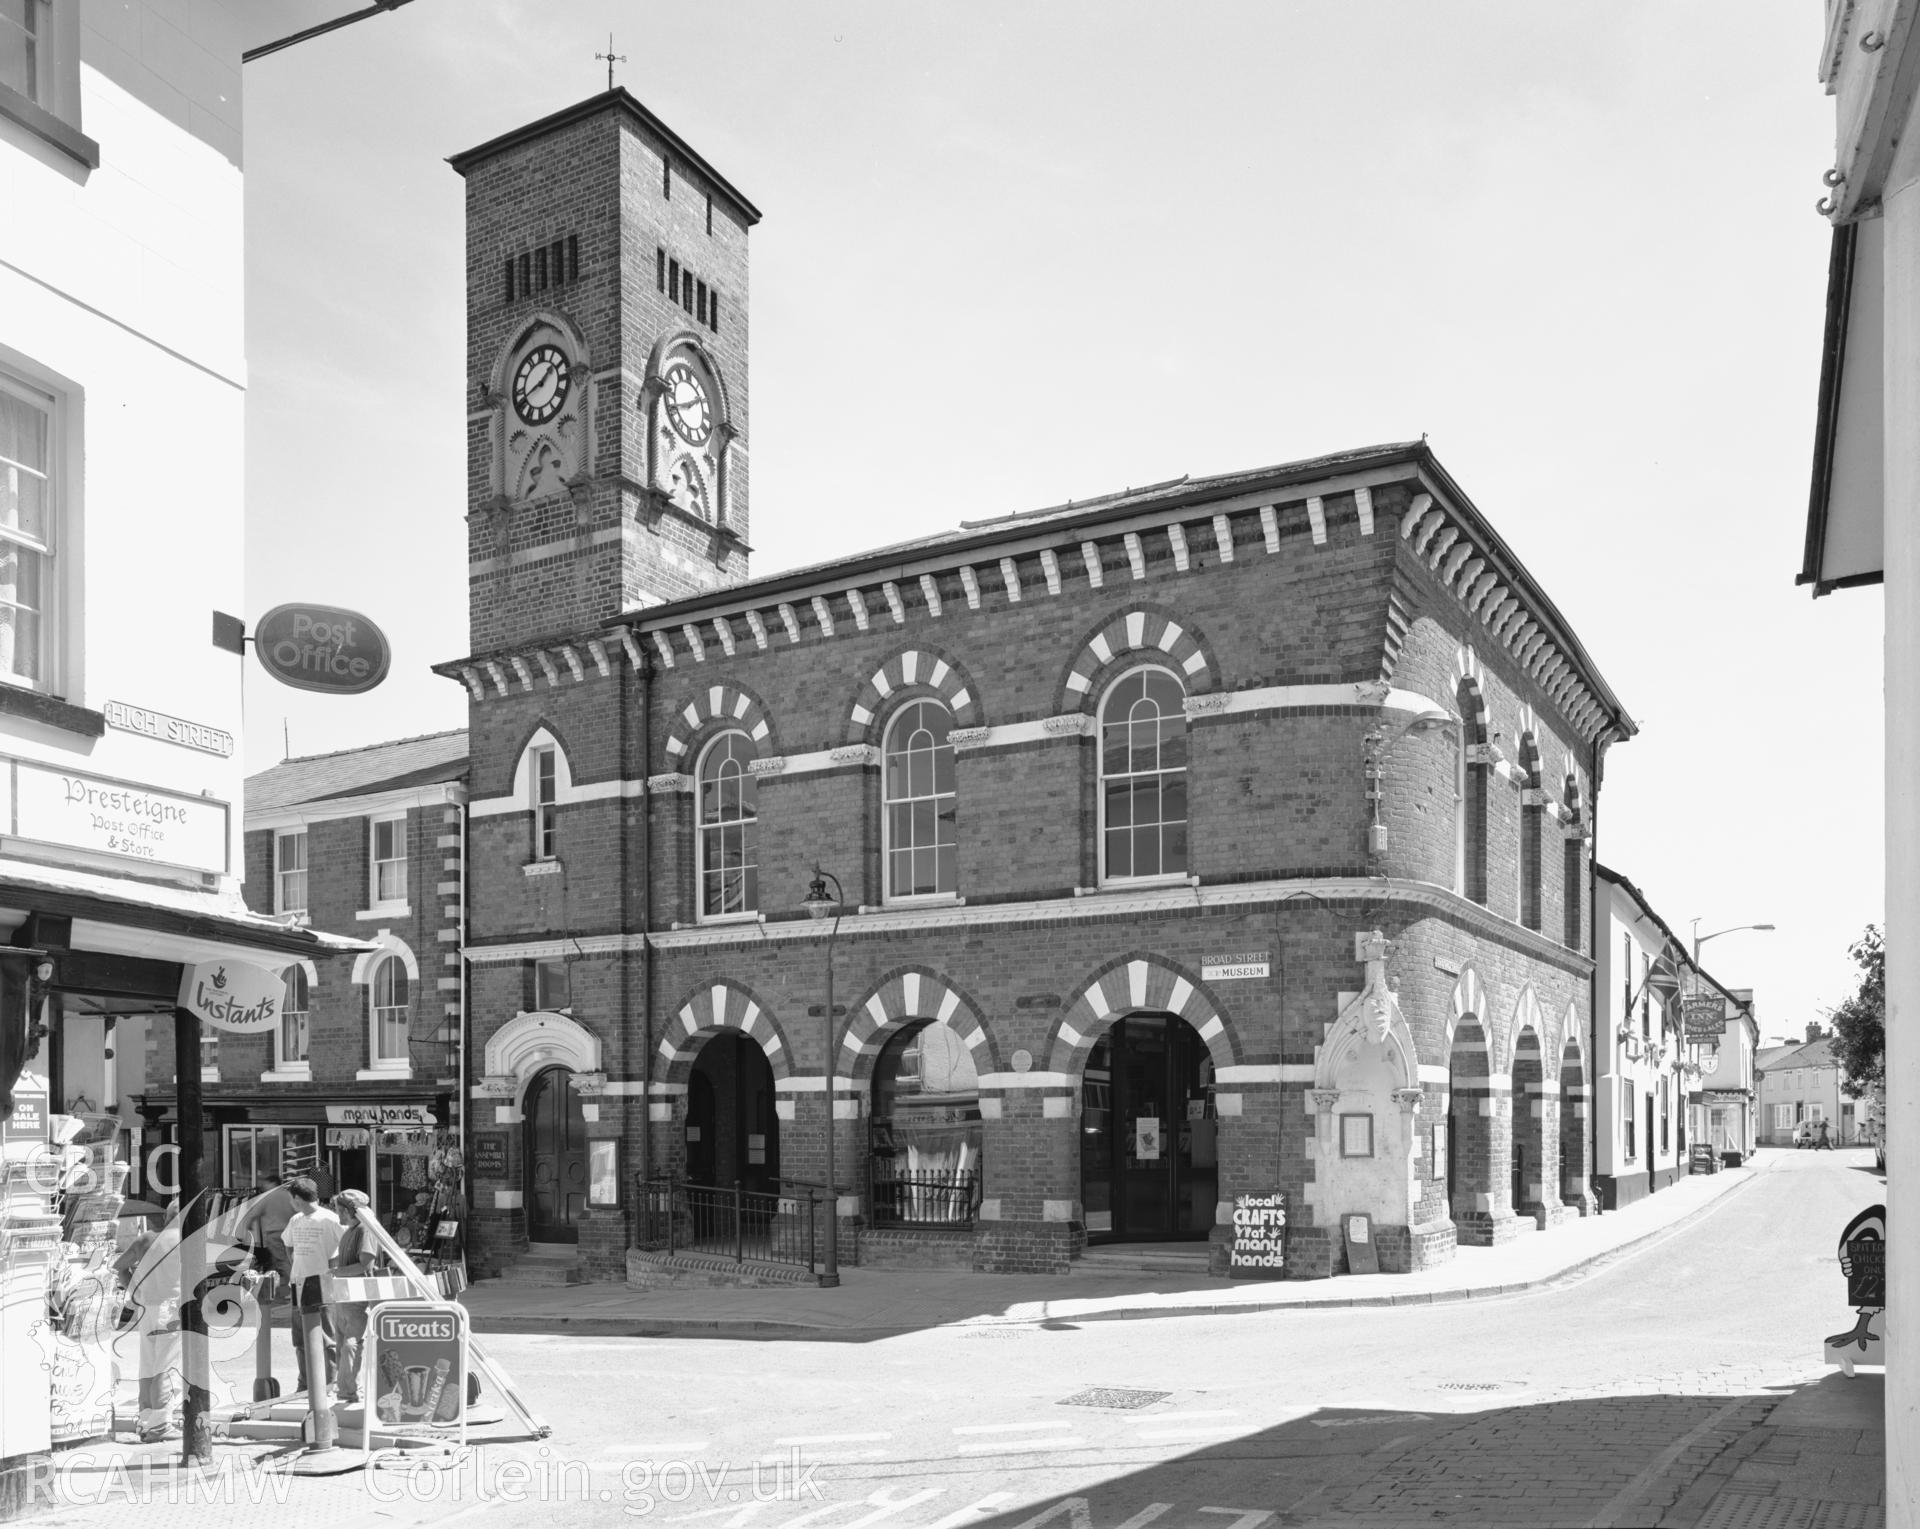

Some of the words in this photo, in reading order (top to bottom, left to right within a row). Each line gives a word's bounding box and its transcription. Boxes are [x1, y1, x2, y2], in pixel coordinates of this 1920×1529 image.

[292, 613, 357, 647] Post
[273, 640, 370, 678] Office
[109, 703, 158, 735] HIGH
[167, 720, 229, 754] STREET
[62, 777, 187, 825] Presteigne
[90, 812, 124, 832] Post
[127, 822, 165, 841] Office
[107, 834, 120, 849] &
[120, 838, 155, 857] Store
[1201, 954, 1232, 966] BROAD
[1235, 951, 1272, 963] STREET
[1221, 966, 1264, 977] MUSEUM
[196, 980, 275, 1024] Instants
[1684, 1001, 1723, 1012] ARMERS
[18, 1103, 34, 1112] ON
[12, 1112, 40, 1121] SALE
[343, 1108, 377, 1123] many
[381, 1108, 419, 1121] hands
[12, 1121, 40, 1129] HERE
[482, 1142, 497, 1150] THE
[473, 1151, 505, 1159] ASSEMBLY
[478, 1160, 502, 1168] ROOMS
[1245, 1194, 1275, 1207] local
[1233, 1208, 1286, 1226] CRAFTS
[1251, 1226, 1266, 1239] at
[1234, 1239, 1282, 1256] many
[1230, 1250, 1284, 1267] hands
[385, 1319, 451, 1338] Treats
